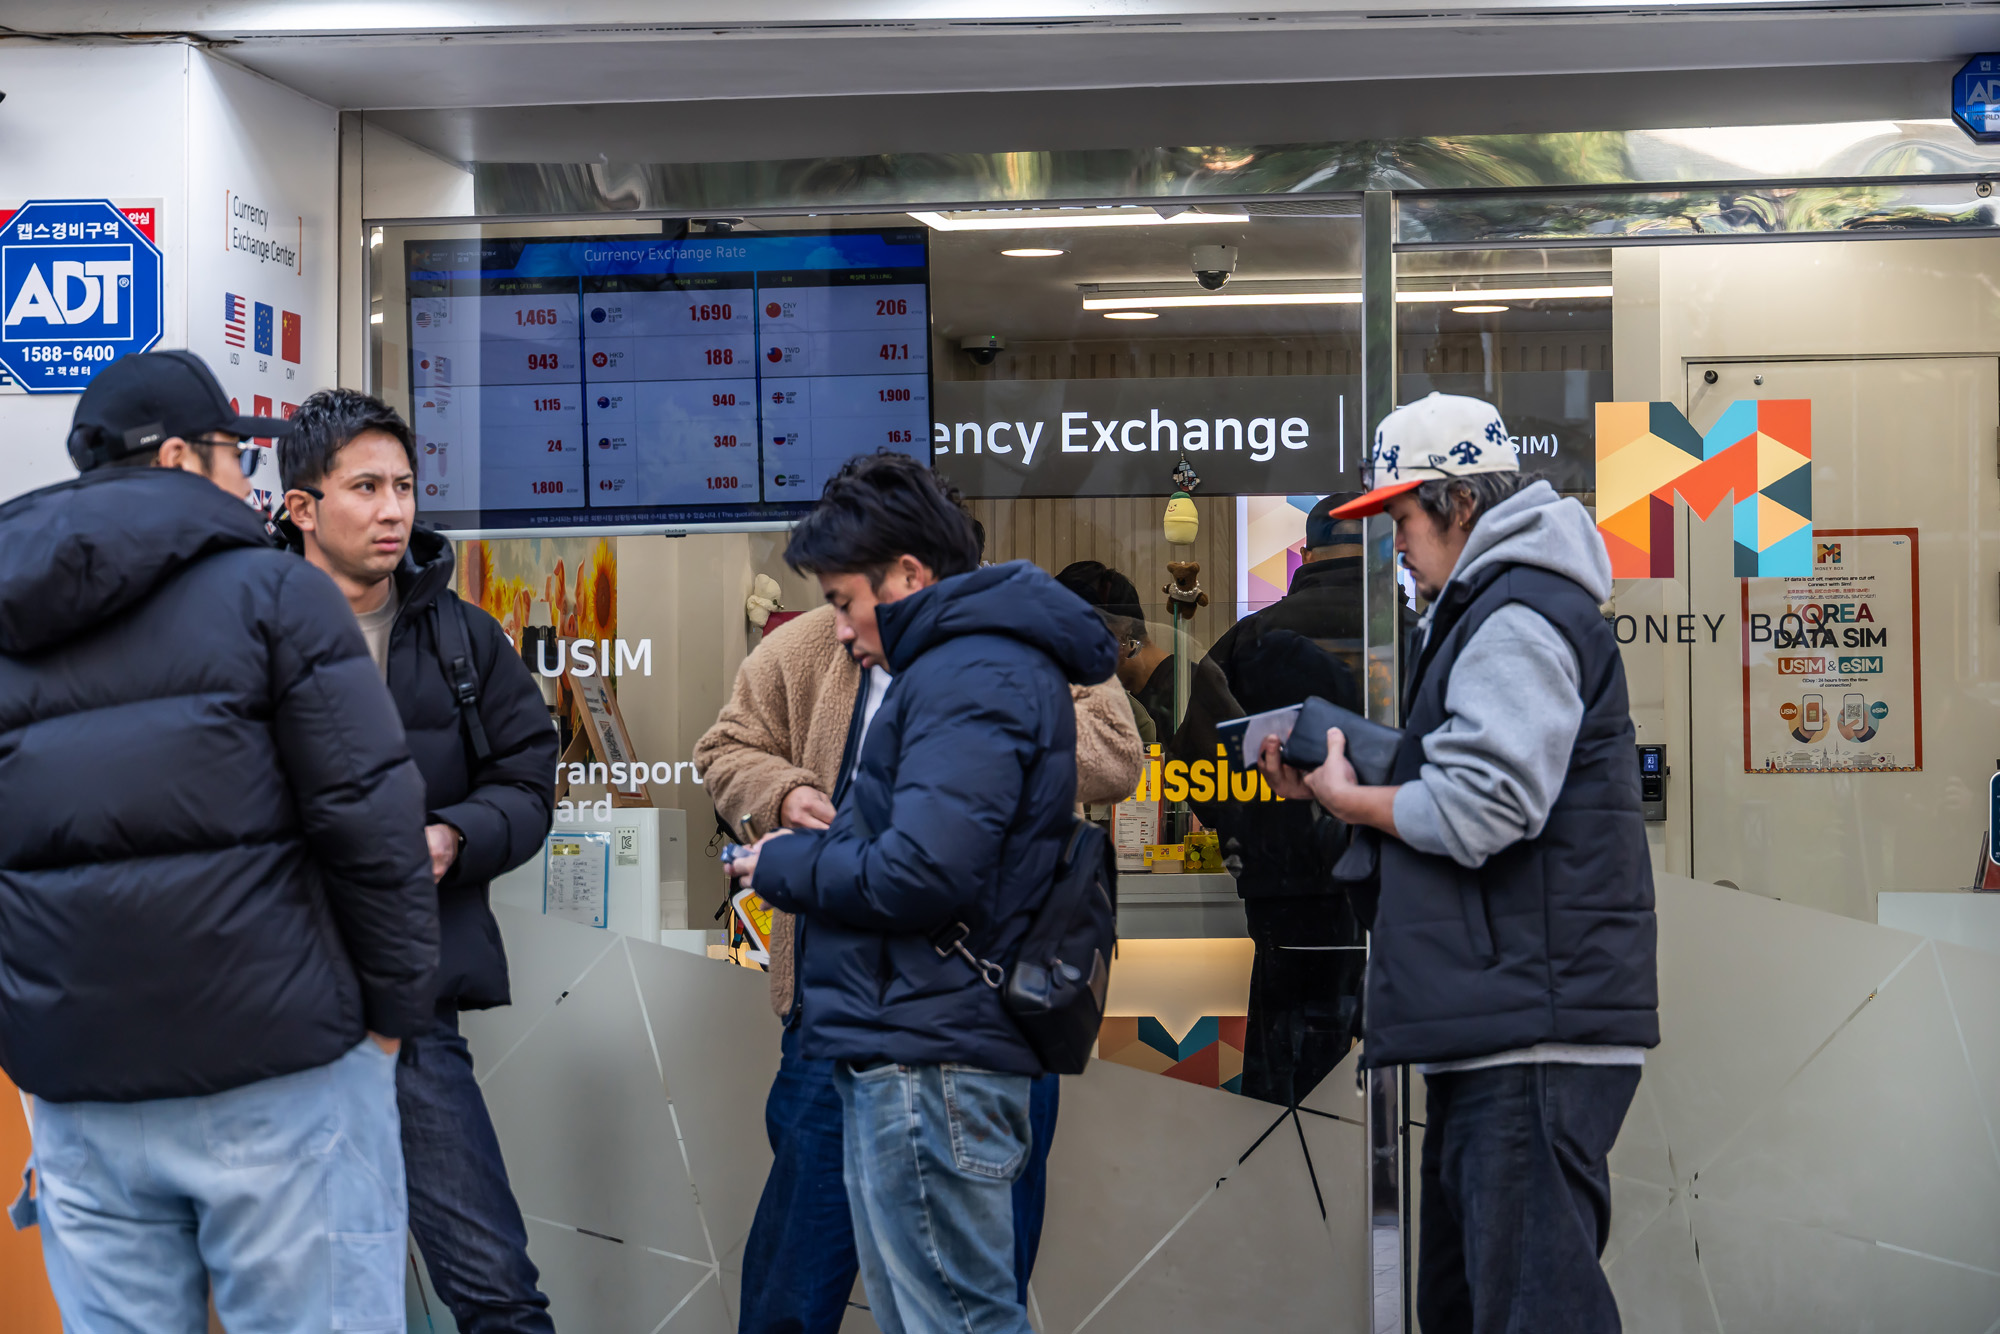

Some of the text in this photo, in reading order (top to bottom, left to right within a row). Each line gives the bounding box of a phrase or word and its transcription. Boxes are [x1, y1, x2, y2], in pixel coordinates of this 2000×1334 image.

[1973, 112, 2000, 121] WORLD
[233, 196, 269, 232] Currency
[17, 221, 119, 240] 캡스경비구역
[233, 227, 296, 268] Exchange Center
[584, 246, 747, 263] Currency Exchange Rate
[689, 304, 732, 322] 1,690
[876, 299, 907, 316] 206
[515, 308, 557, 326] 1,465
[22, 345, 115, 362] 1588-6400
[230, 352, 240, 366] USD
[705, 349, 733, 365] 188
[880, 344, 908, 360] 47.1
[259, 360, 268, 373] EUR
[528, 354, 558, 370] 943
[44, 366, 92, 376] 고객센터
[286, 368, 295, 380] CNY
[712, 393, 735, 406] 940
[879, 389, 910, 402] 1,900
[534, 398, 561, 412] 1,115
[714, 435, 737, 448] 340
[887, 430, 912, 443] 16.5
[932, 412, 1310, 465] ency Exchange
[547, 440, 562, 452] 24
[1508, 434, 1559, 458] SIM)
[532, 481, 564, 494] 1,800
[706, 476, 738, 490] 1,030
[1786, 603, 1874, 624] KOREA
[1614, 613, 1832, 644] ONEY BOX
[1774, 628, 1887, 648] DATA SIM
[536, 638, 652, 678] USIM
[1781, 658, 1880, 673] USIM & eSIM
[555, 760, 704, 792] ransport
[557, 793, 612, 822] ard
